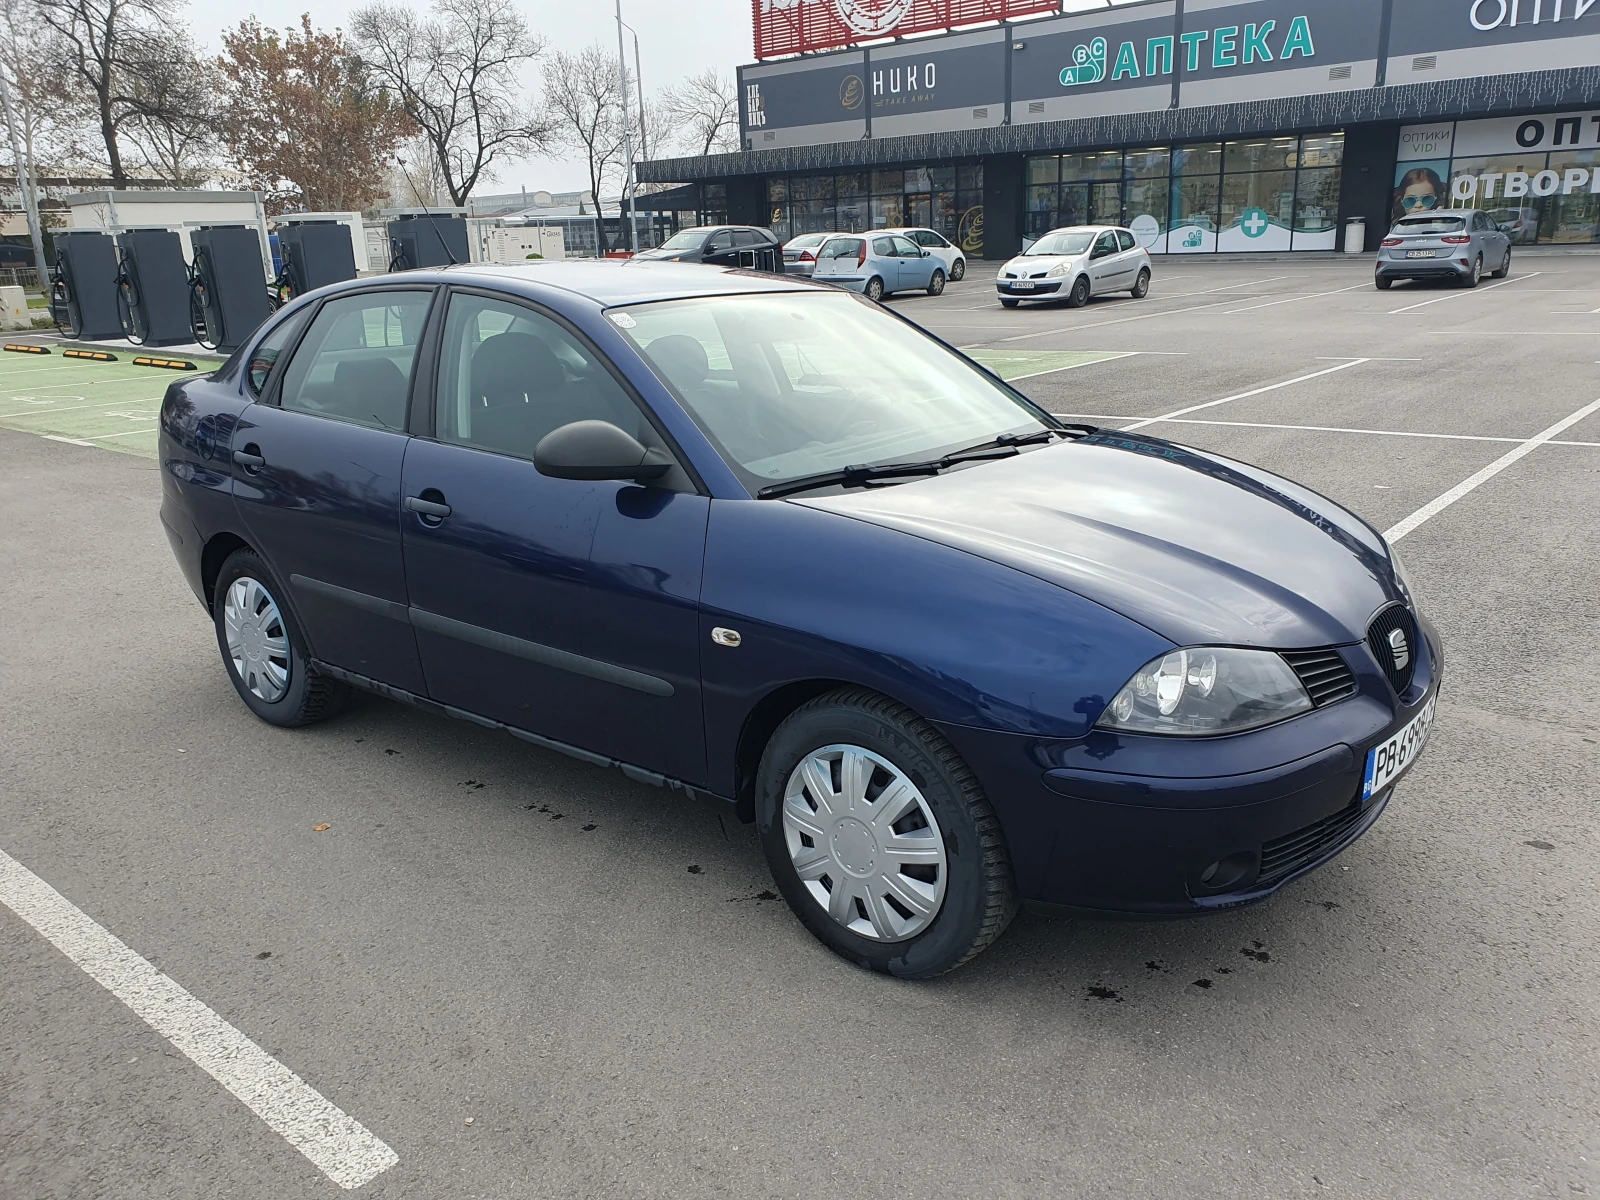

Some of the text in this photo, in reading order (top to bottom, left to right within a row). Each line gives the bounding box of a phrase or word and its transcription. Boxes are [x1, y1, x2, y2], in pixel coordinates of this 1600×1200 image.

[1111, 15, 1315, 81] АПТЕКА
[885, 93, 936, 106] TAKE AWAY
[1402, 130, 1450, 143] ОПТИКИ
[1412, 143, 1437, 153] VIDI
[1375, 739, 1397, 787] PB
[1363, 780, 1372, 794] BG
